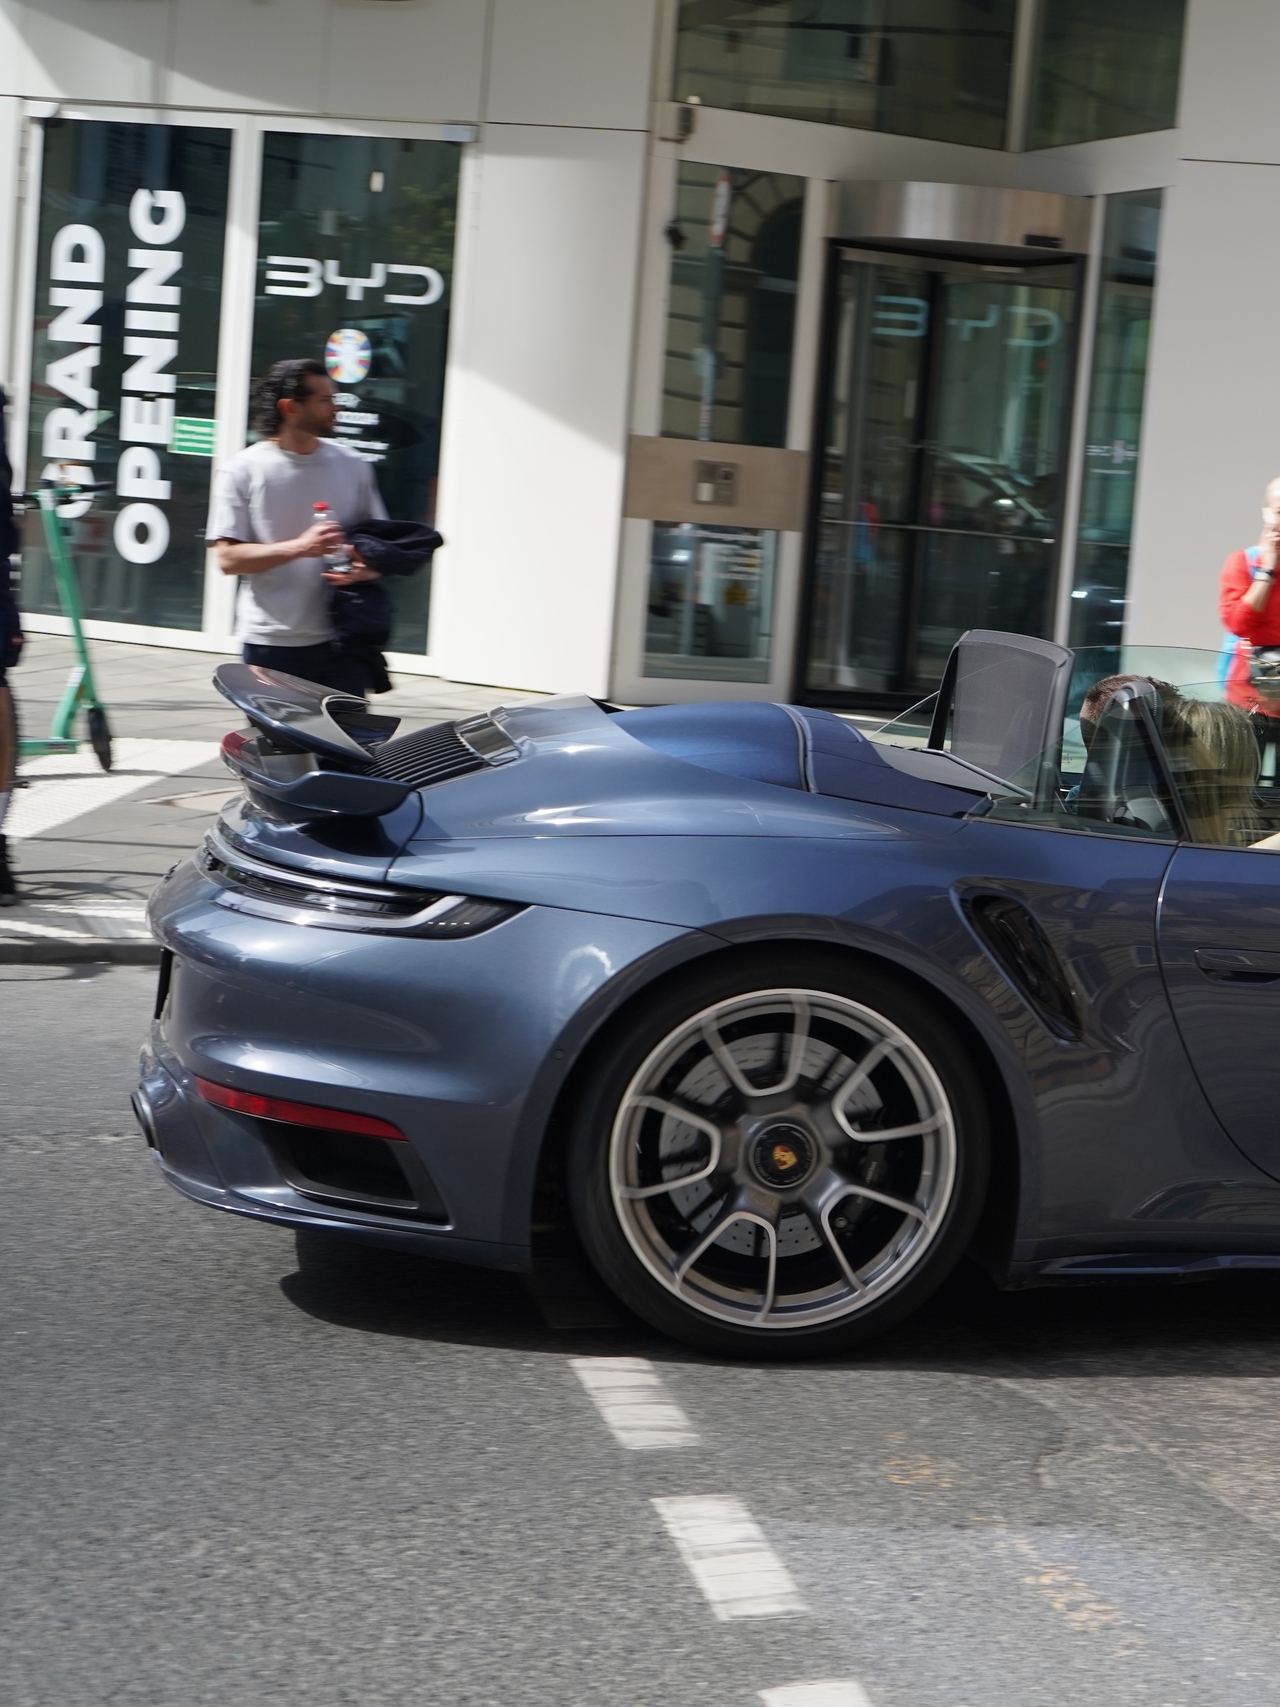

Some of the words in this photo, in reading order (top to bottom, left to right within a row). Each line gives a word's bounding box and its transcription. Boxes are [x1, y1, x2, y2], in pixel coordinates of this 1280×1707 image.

[264, 255, 445, 306] BYD
[872, 294, 1064, 348] BYD
[41, 223, 105, 519] GRAND
[112, 188, 187, 565] OPENING
